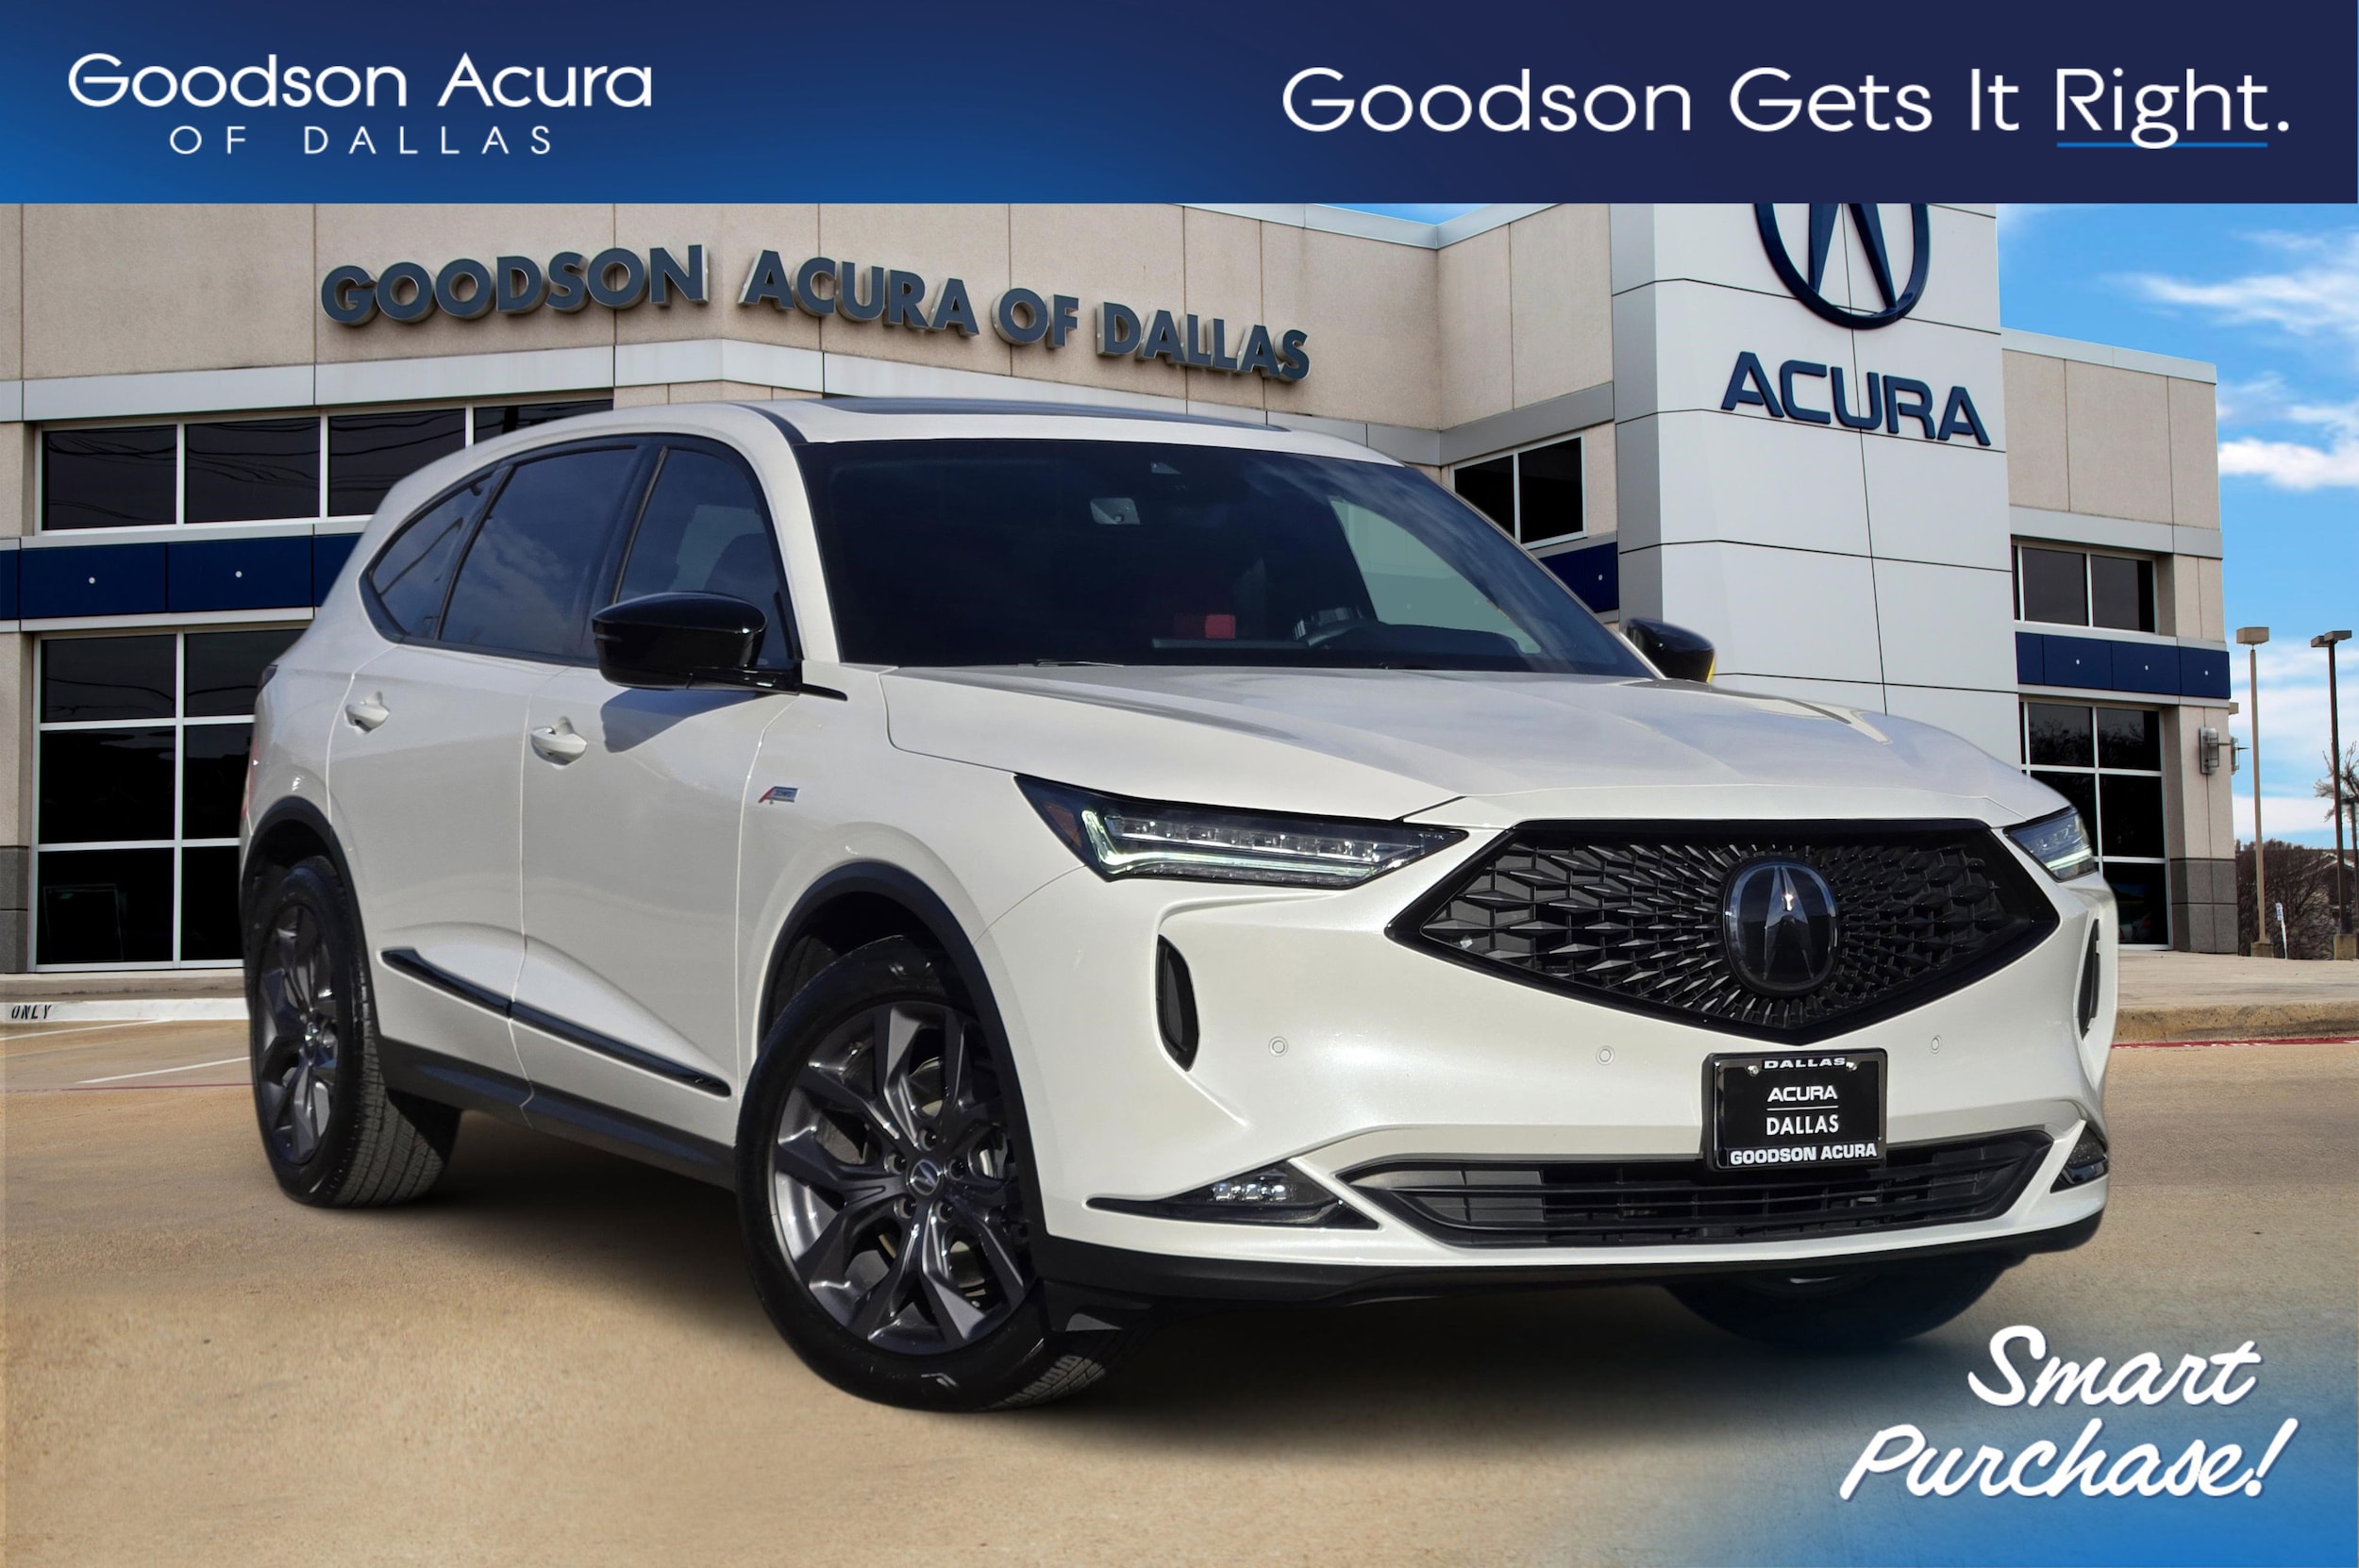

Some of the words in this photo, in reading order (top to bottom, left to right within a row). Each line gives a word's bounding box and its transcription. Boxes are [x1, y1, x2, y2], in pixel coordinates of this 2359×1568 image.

[321, 243, 710, 327] GOODSON
[738, 249, 979, 336] ACURA
[992, 287, 1079, 349] OF
[1096, 301, 1311, 382] DALLAS
[1720, 351, 1992, 447] ACURA
[11, 1005, 52, 1020] ONLY
[1764, 1058, 1847, 1070] DALLAS
[1766, 1085, 1838, 1103] ACURA
[1766, 1113, 1839, 1136] DALLAS
[1730, 1146, 1817, 1166] GOODSON
[1820, 1143, 1878, 1161] ACURA
